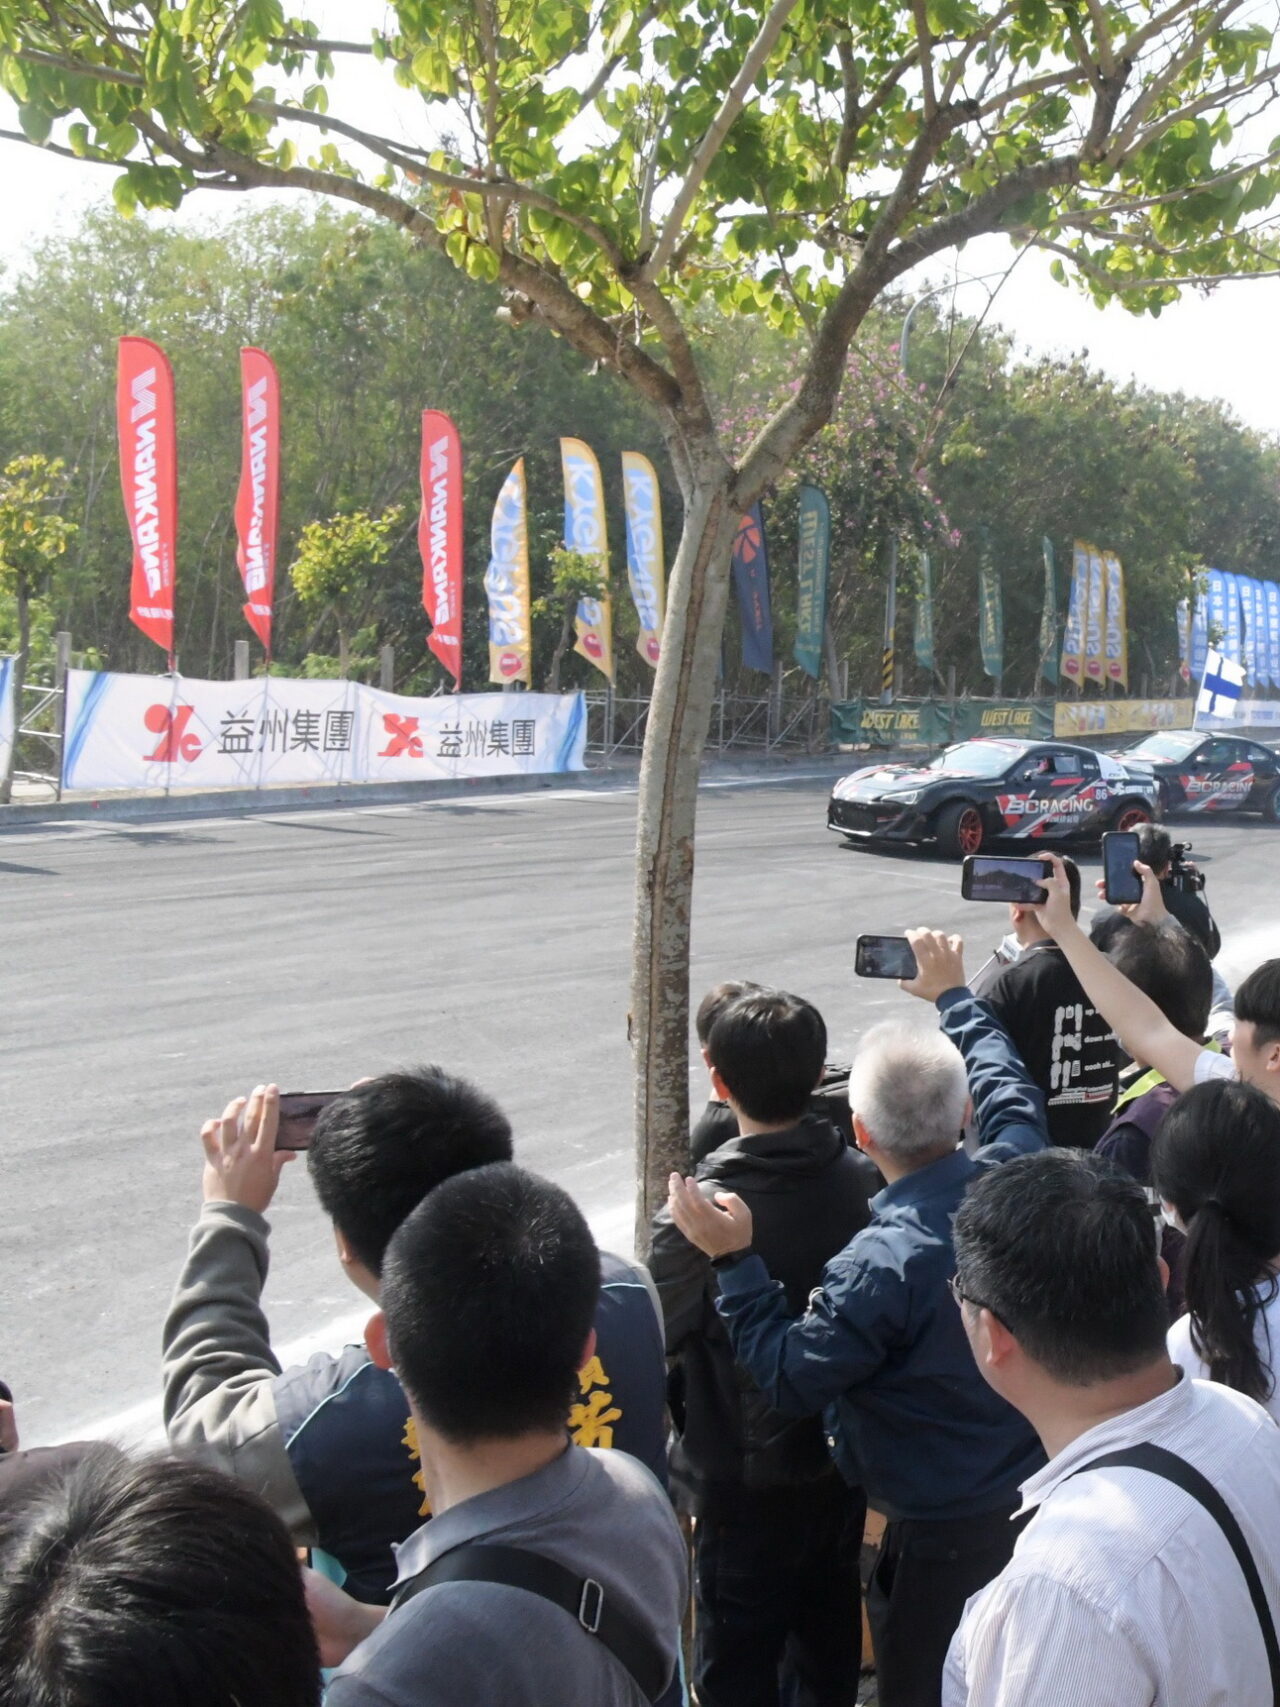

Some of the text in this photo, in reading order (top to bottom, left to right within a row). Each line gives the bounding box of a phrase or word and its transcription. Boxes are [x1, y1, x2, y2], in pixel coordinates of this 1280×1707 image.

[217, 709, 354, 754] 益州集團
[436, 719, 536, 758] 益州集團
[1095, 788, 1108, 800] 86
